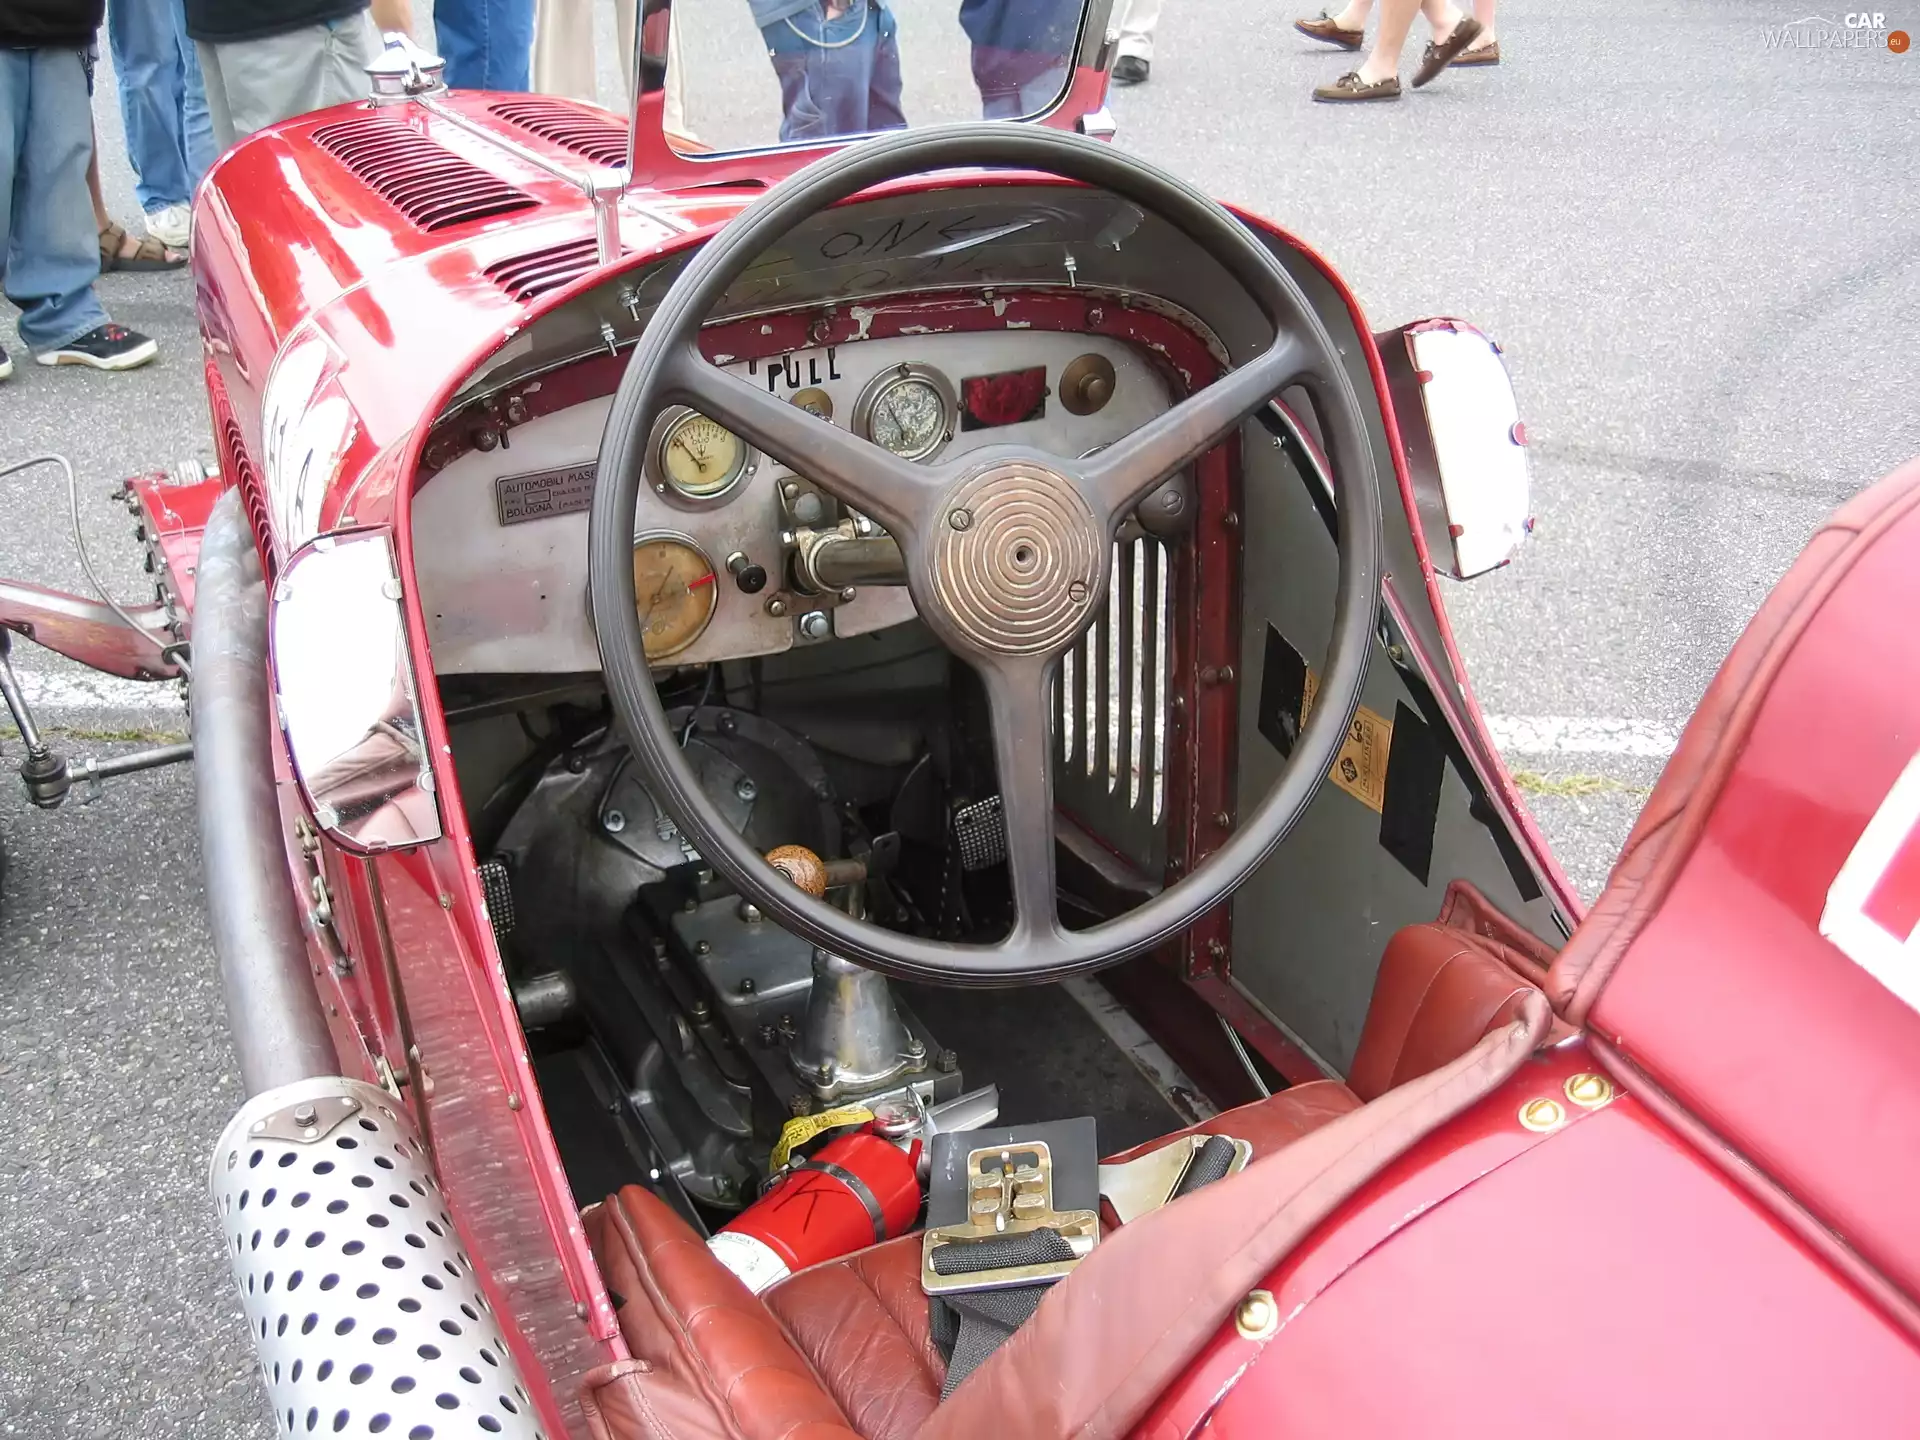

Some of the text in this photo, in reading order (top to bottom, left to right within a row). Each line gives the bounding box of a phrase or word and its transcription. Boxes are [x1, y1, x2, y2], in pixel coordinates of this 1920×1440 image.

[767, 357, 841, 392] PULL
[504, 477, 563, 495] AUTOMOBILI
[506, 503, 553, 518] BOLOGNA
